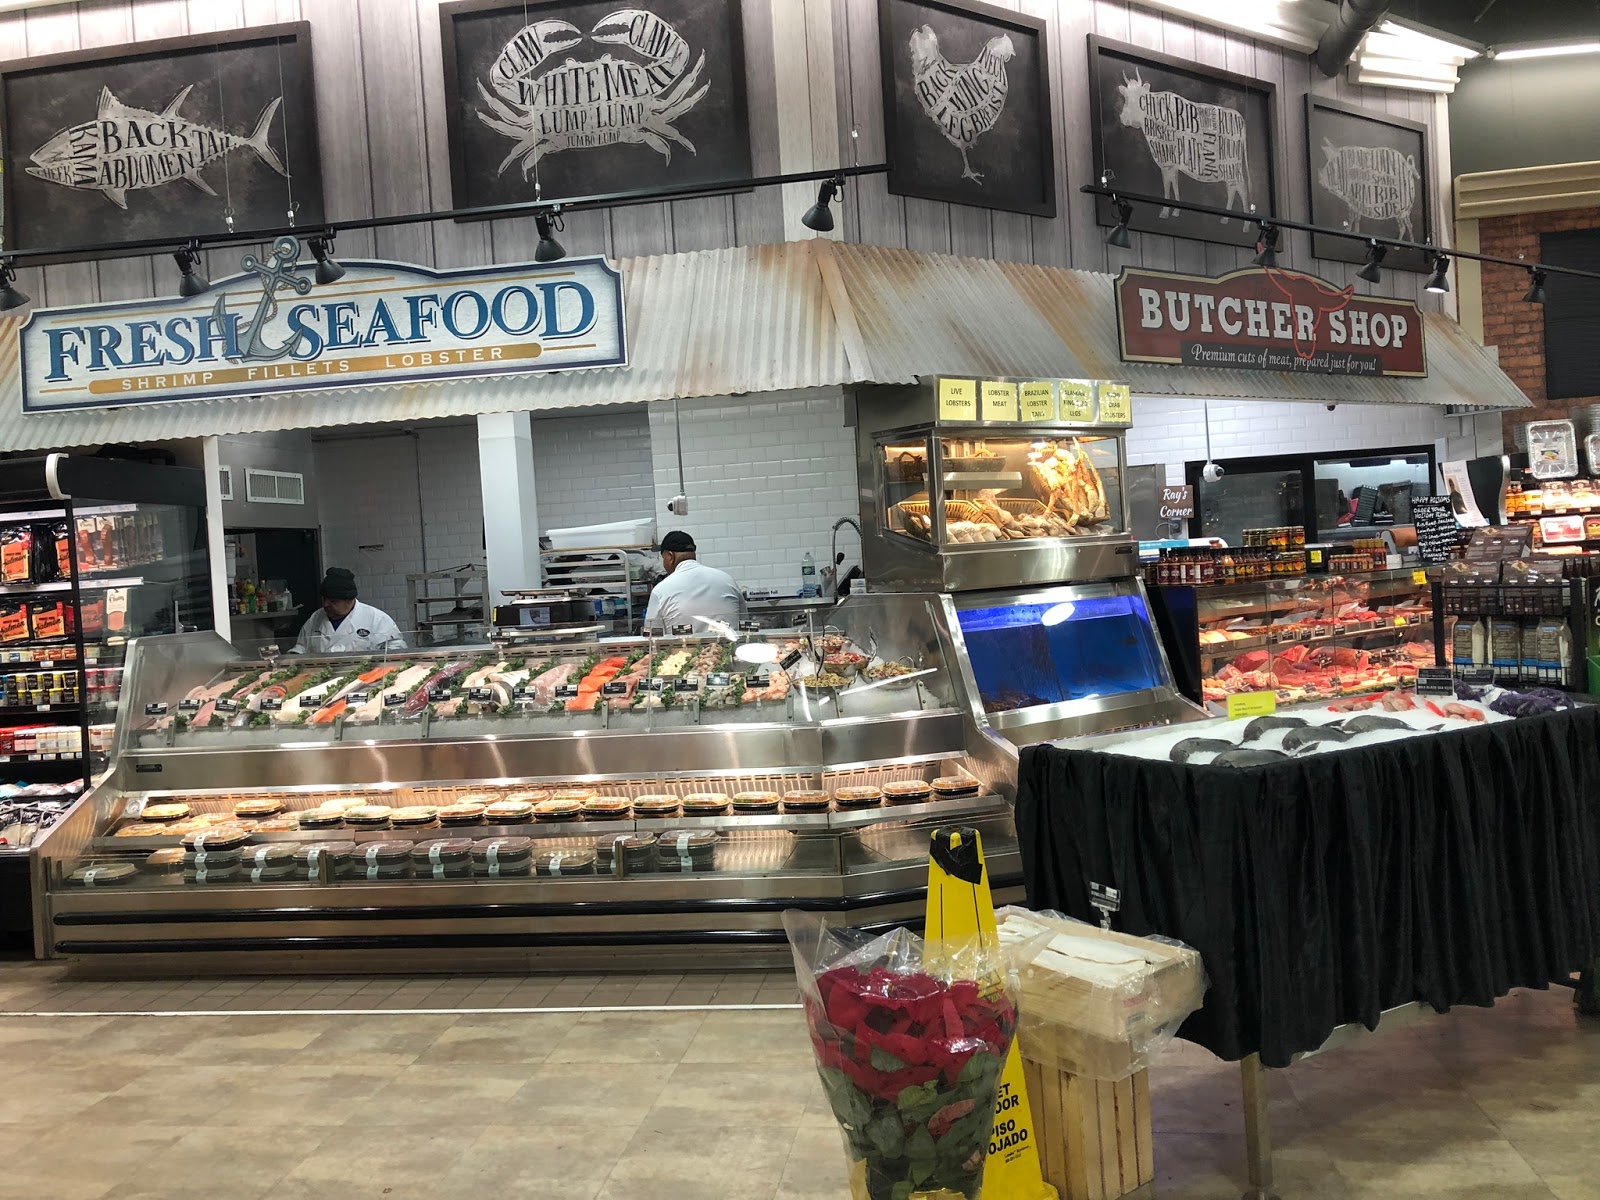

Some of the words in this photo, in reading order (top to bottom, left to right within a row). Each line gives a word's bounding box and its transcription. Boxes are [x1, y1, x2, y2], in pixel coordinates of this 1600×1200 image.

[498, 25, 545, 81] CLAW
[628, 13, 679, 59] CLAW
[979, 46, 1008, 86] NECK
[517, 67, 601, 107] WHITE
[603, 63, 677, 102] MEAT
[917, 60, 958, 109] BACK
[949, 67, 991, 111] WING
[540, 109, 588, 135] LUMP
[596, 102, 645, 128] LUMP
[936, 106, 973, 142] LEG
[970, 80, 1006, 133] BREAST
[1139, 94, 1175, 128] CHUCK
[1174, 97, 1200, 134] RIB
[1218, 108, 1244, 137] RUMP
[100, 120, 191, 154] BACK
[192, 129, 232, 162] TAIL
[566, 134, 596, 148] JUMBO
[598, 130, 621, 146] LUMP
[1144, 117, 1176, 142] BRISKET
[68, 123, 98, 186] KAMA
[1150, 139, 1177, 164] SHANK
[1177, 136, 1204, 176] PLATE
[1203, 131, 1219, 179] FLANK
[99, 151, 195, 189] ABDOMEN
[1374, 185, 1399, 204] RIB
[1374, 202, 1398, 218] SIDE
[42, 312, 245, 383] FRESH
[287, 280, 598, 361] SEAFOOD
[1138, 287, 1316, 342] BUTCHER
[1329, 309, 1408, 348] SHOP
[122, 372, 213, 391] SHRIMP
[248, 360, 349, 380] FILLETS
[385, 347, 504, 368] LOBSTER
[1191, 344, 1236, 361] Premium
[1238, 353, 1256, 363] cuts
[1258, 348, 1268, 368] of
[1269, 355, 1292, 367] meat,
[1294, 353, 1329, 371] prepared
[1329, 355, 1345, 372] just
[1346, 354, 1359, 373] for
[1359, 358, 1377, 374] you!
[1160, 505, 1193, 518] Corner
[1163, 487, 1188, 504] Ray's
[34, 618, 62, 633] Salmon
[995, 1094, 1019, 1114] OOR
[998, 1083, 1011, 1098] ET
[988, 1128, 1028, 1155] OJADO
